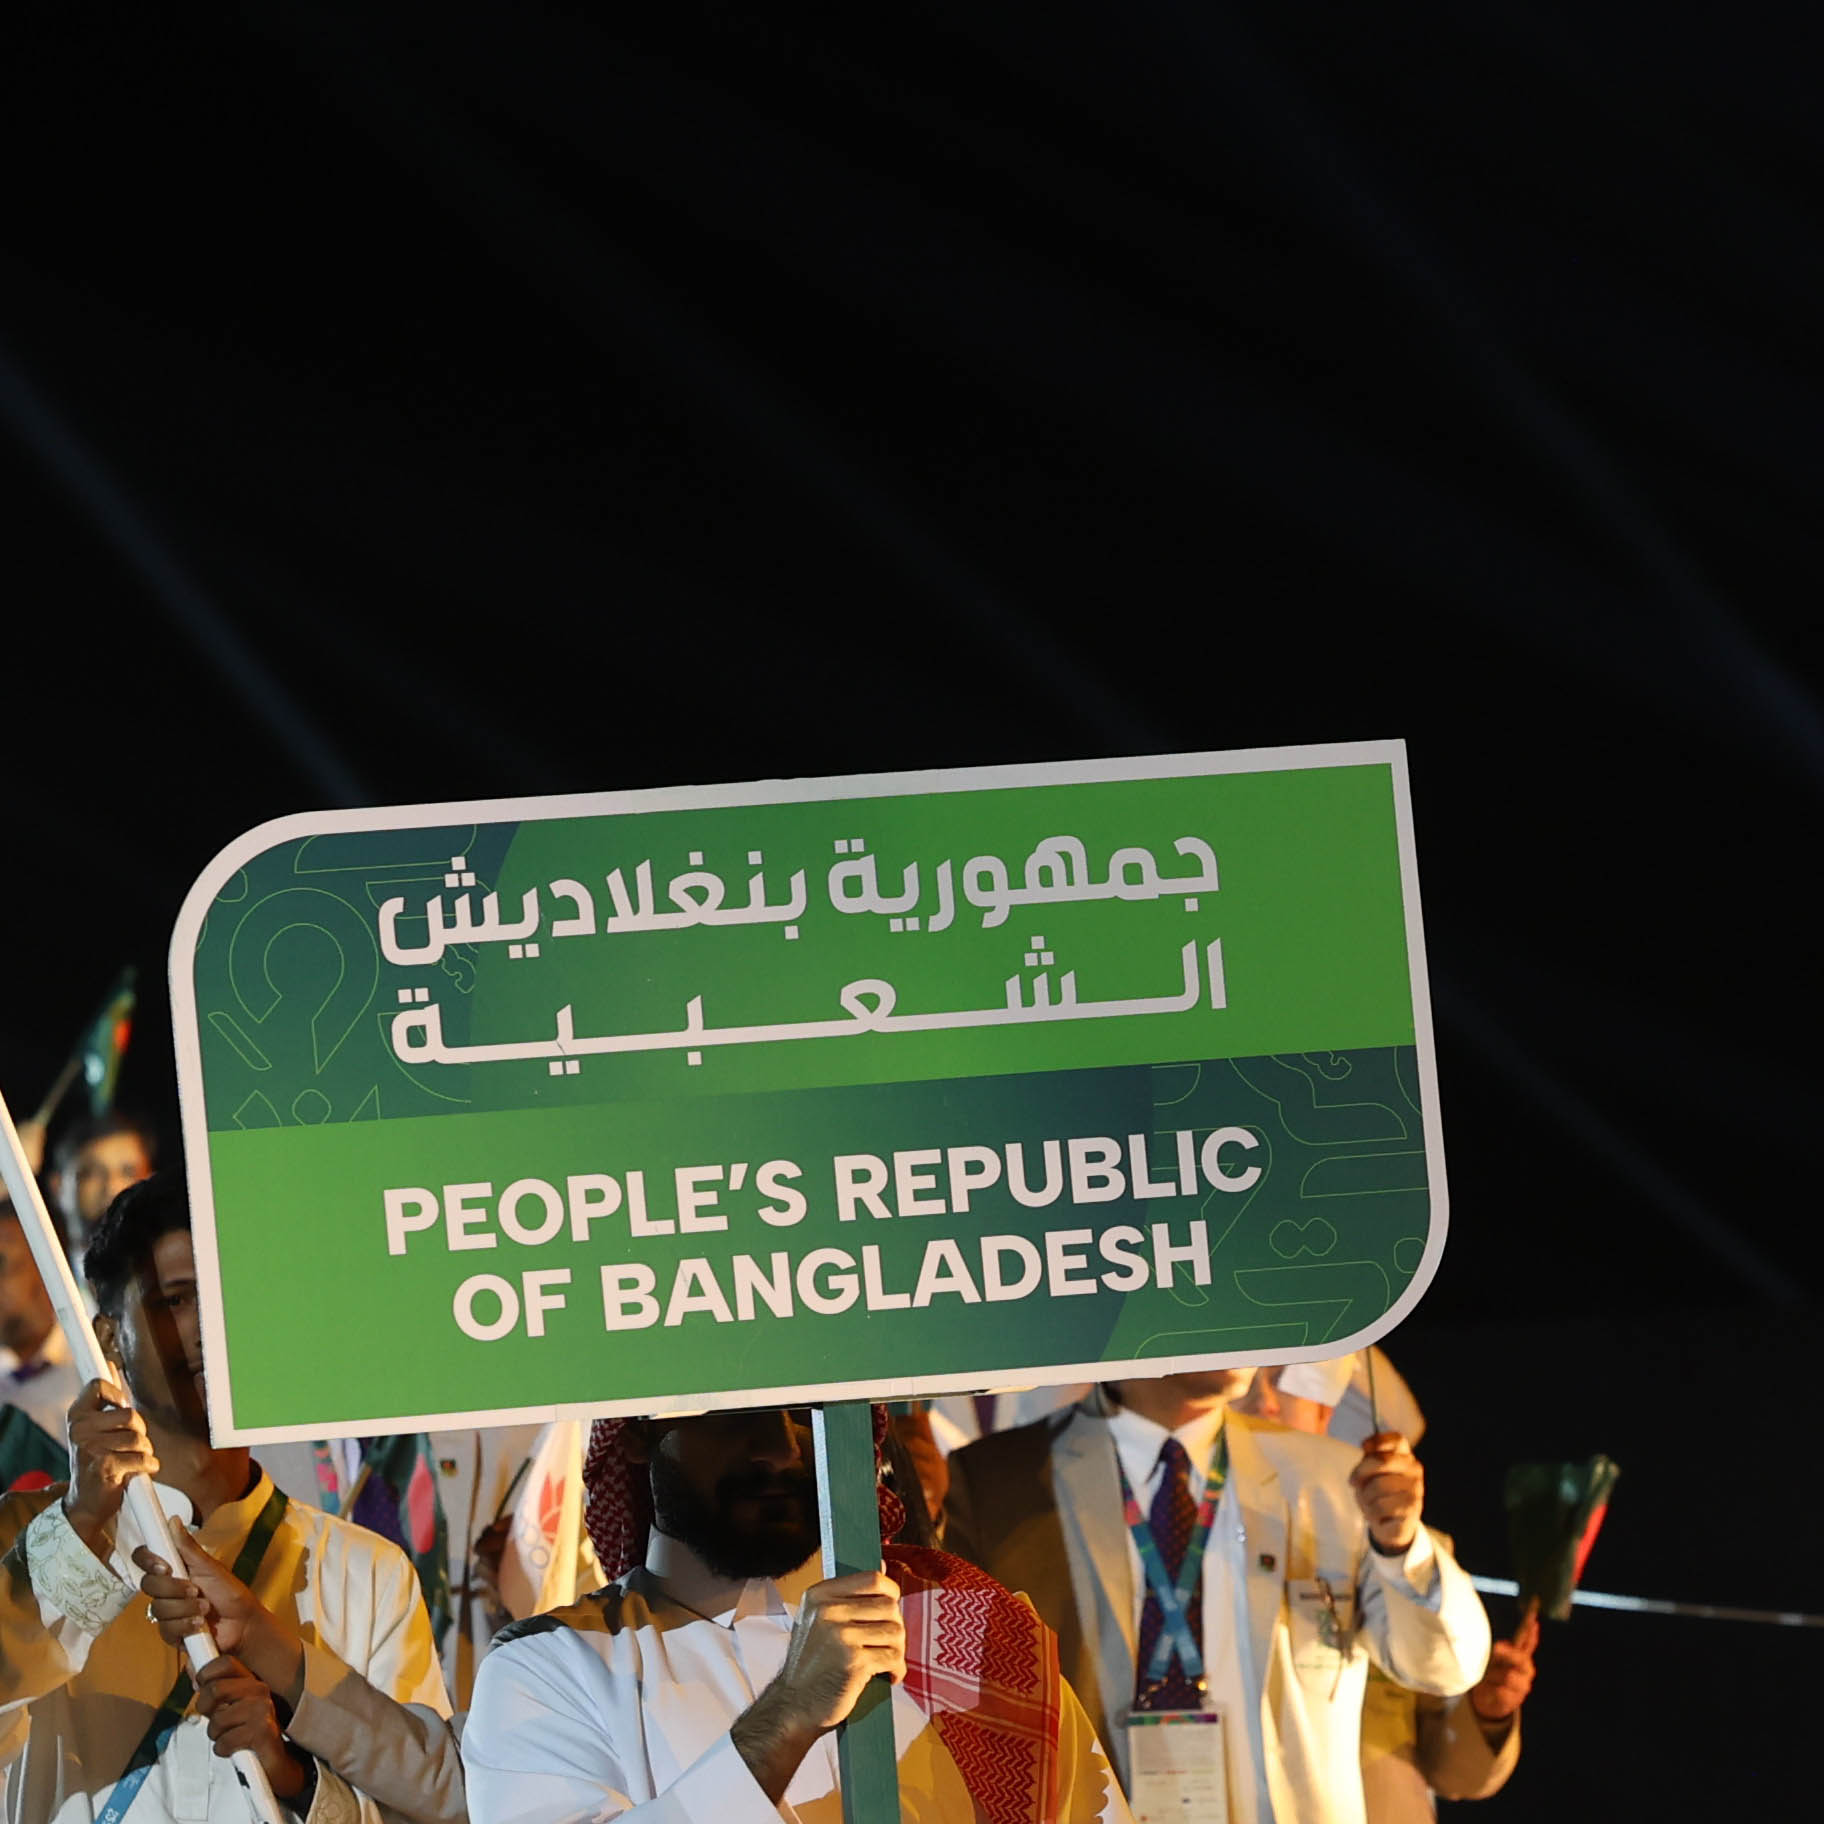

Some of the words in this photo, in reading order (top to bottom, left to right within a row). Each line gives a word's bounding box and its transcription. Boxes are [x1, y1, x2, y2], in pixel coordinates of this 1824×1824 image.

[377, 850, 808, 967] بنغلاديش
[827, 834, 1220, 934] جمهورية
[382, 1158, 809, 1257] PEOPLE'S
[832, 1126, 1263, 1223] REPUBLIC
[451, 1266, 573, 1343] OF
[599, 1220, 1213, 1333] BANGLADESH
